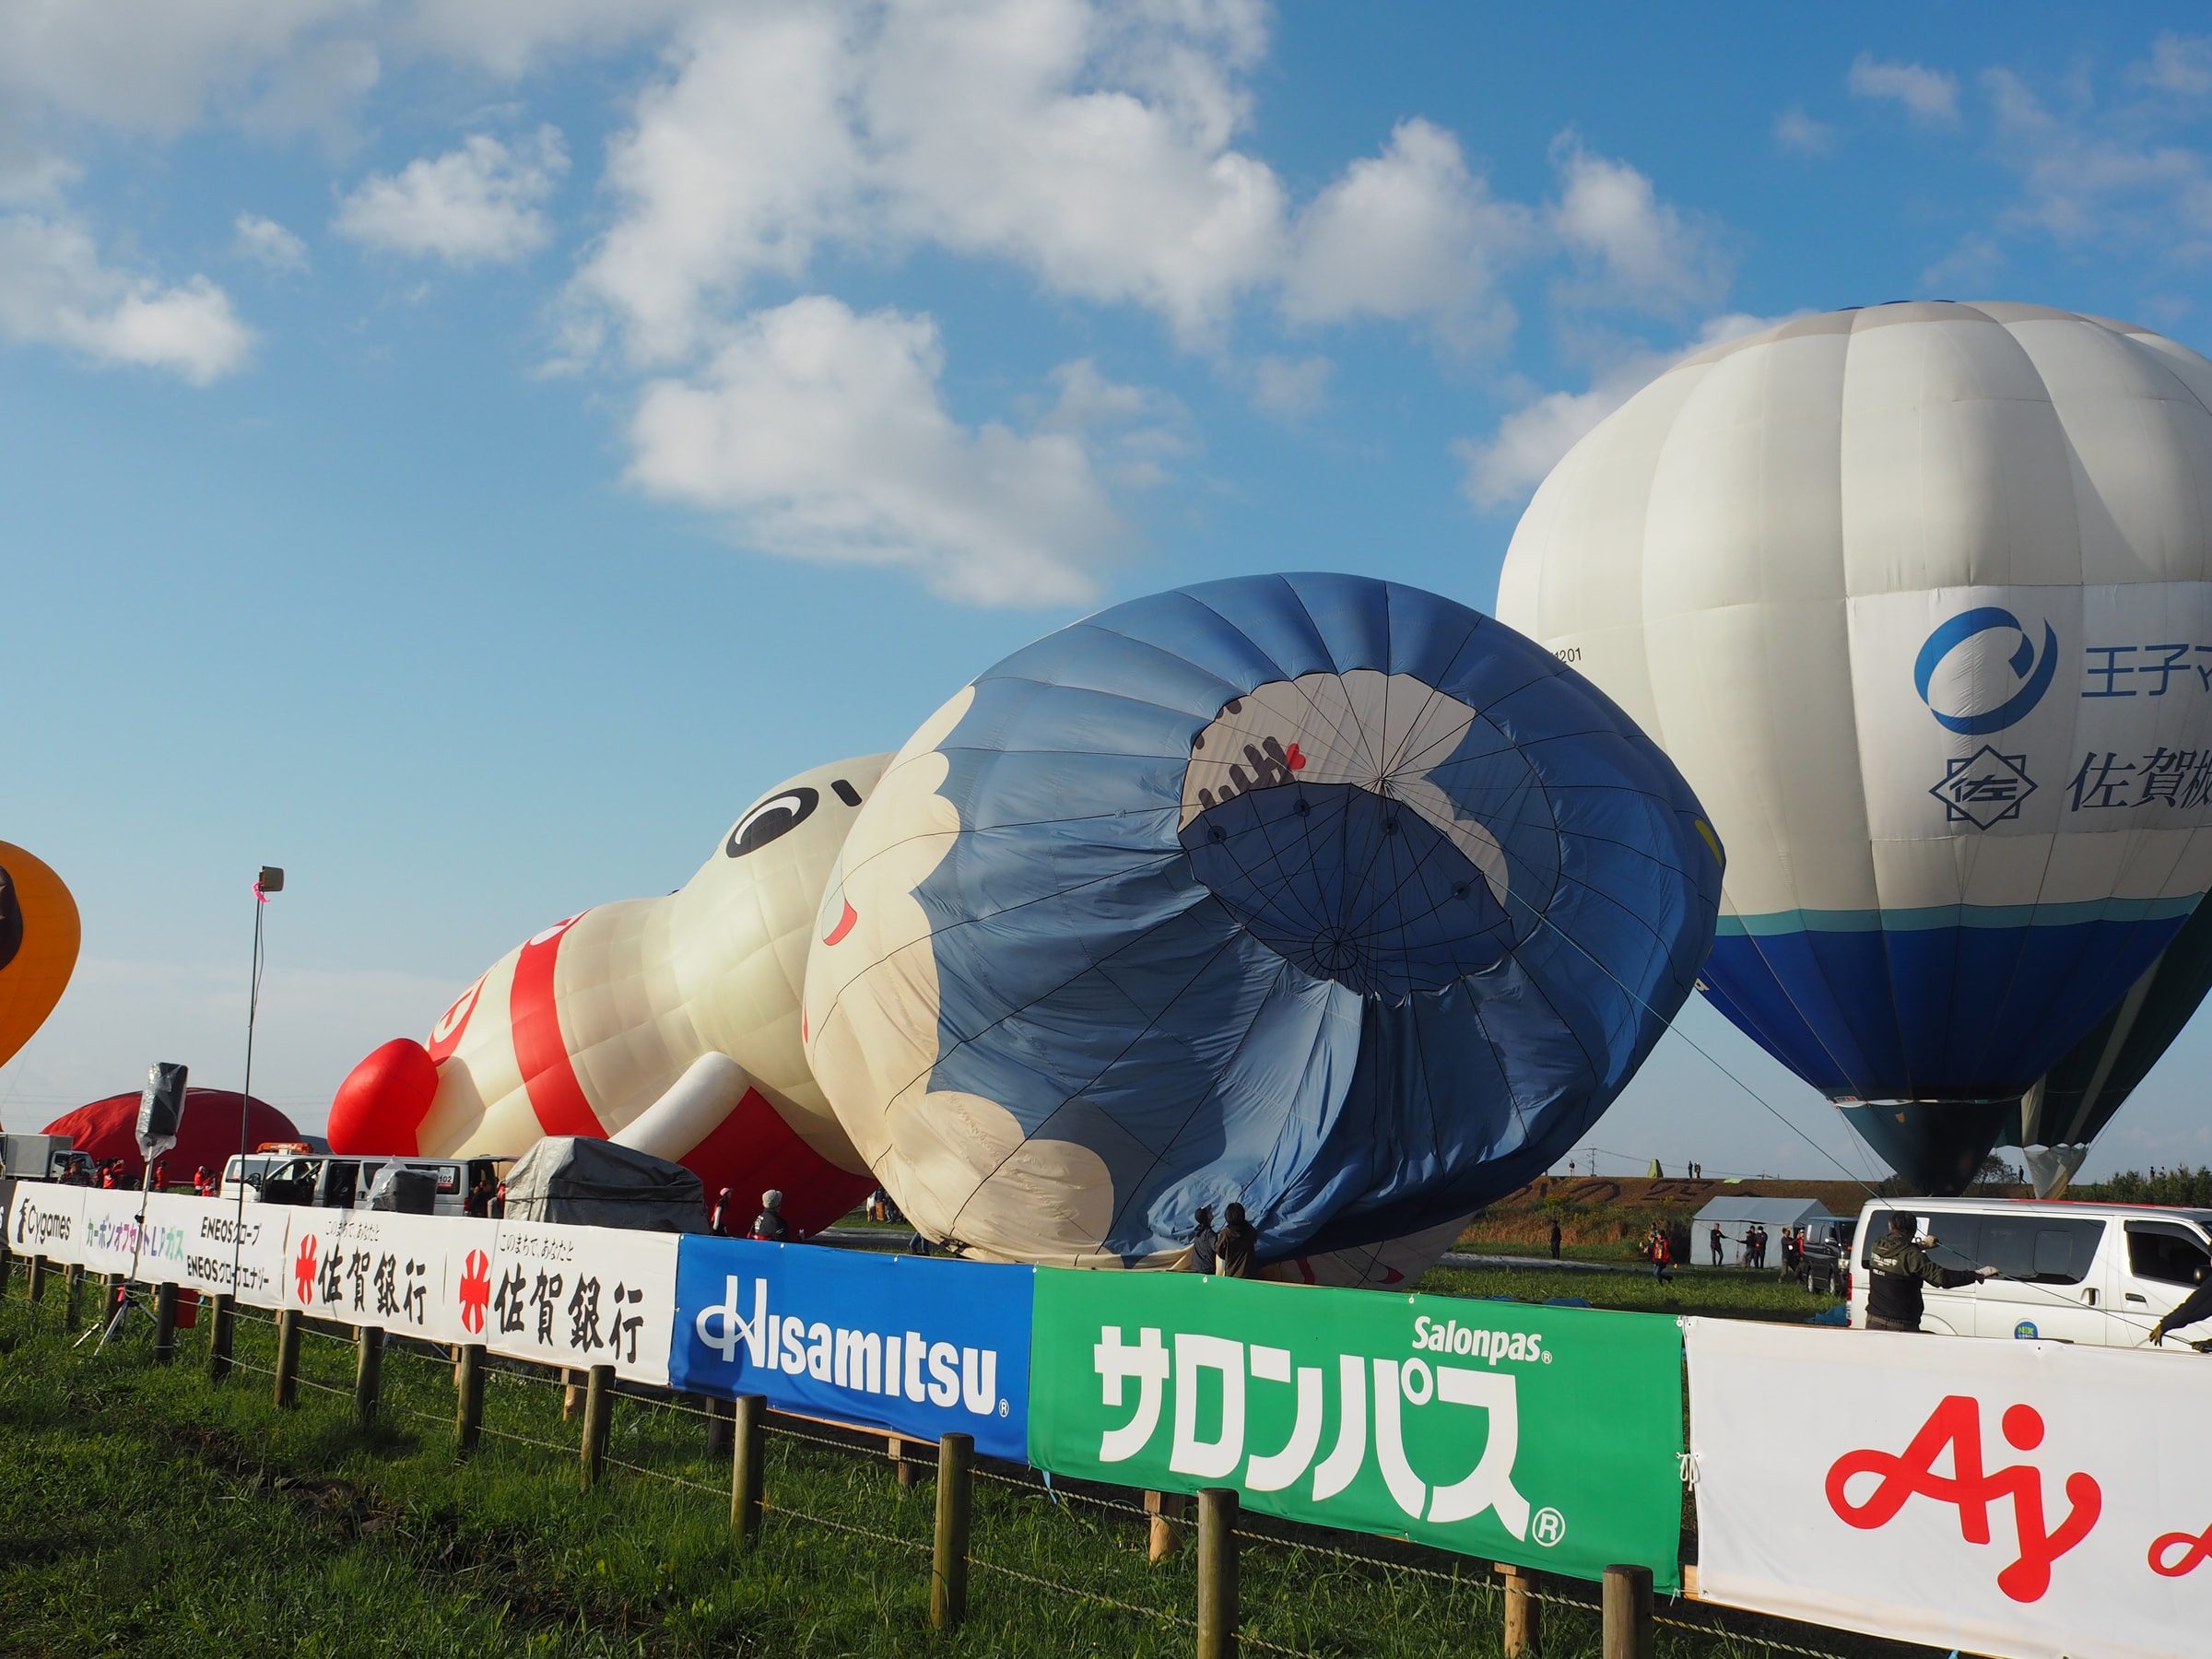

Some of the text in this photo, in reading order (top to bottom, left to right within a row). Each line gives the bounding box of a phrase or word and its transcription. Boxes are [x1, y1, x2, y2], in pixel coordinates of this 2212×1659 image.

[29, 1205, 72, 1244] Cygames
[87, 1213, 184, 1261] カーボンオフセトLPガス
[318, 1243, 427, 1325] 佐賀銀行
[494, 1261, 644, 1364] 佐賀銀行
